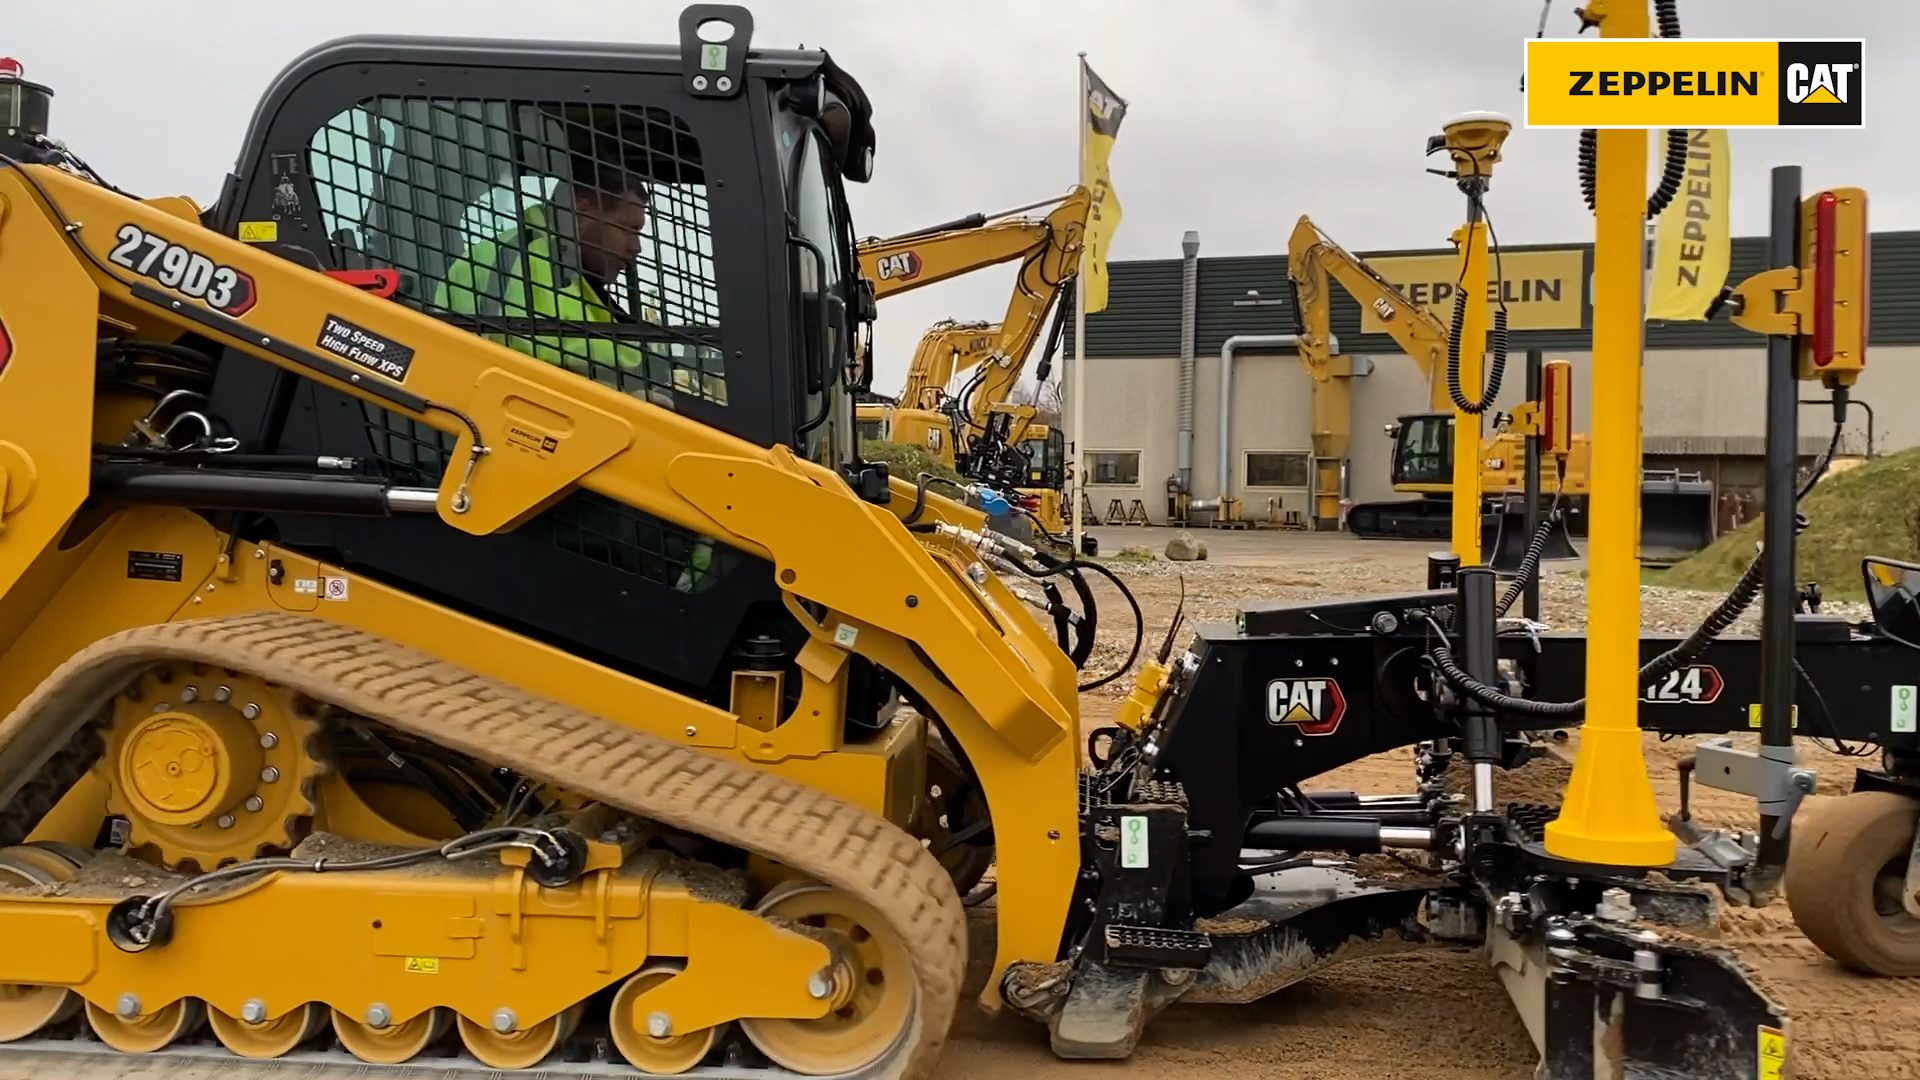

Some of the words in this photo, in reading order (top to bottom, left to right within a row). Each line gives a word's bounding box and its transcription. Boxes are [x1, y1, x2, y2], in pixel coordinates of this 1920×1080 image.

[1089, 89, 1120, 120] AT
[1677, 129, 1712, 288] ZEPPELIN
[109, 225, 238, 308] 279D3
[877, 252, 911, 280] CAT
[1392, 279, 1561, 305] EPELIN
[326, 320, 351, 338] TWO
[351, 331, 385, 353] SPEED
[321, 335, 349, 354] HIGH
[348, 347, 380, 366] FLOW
[377, 359, 404, 377] XPS
[1268, 681, 1327, 722] CAT
